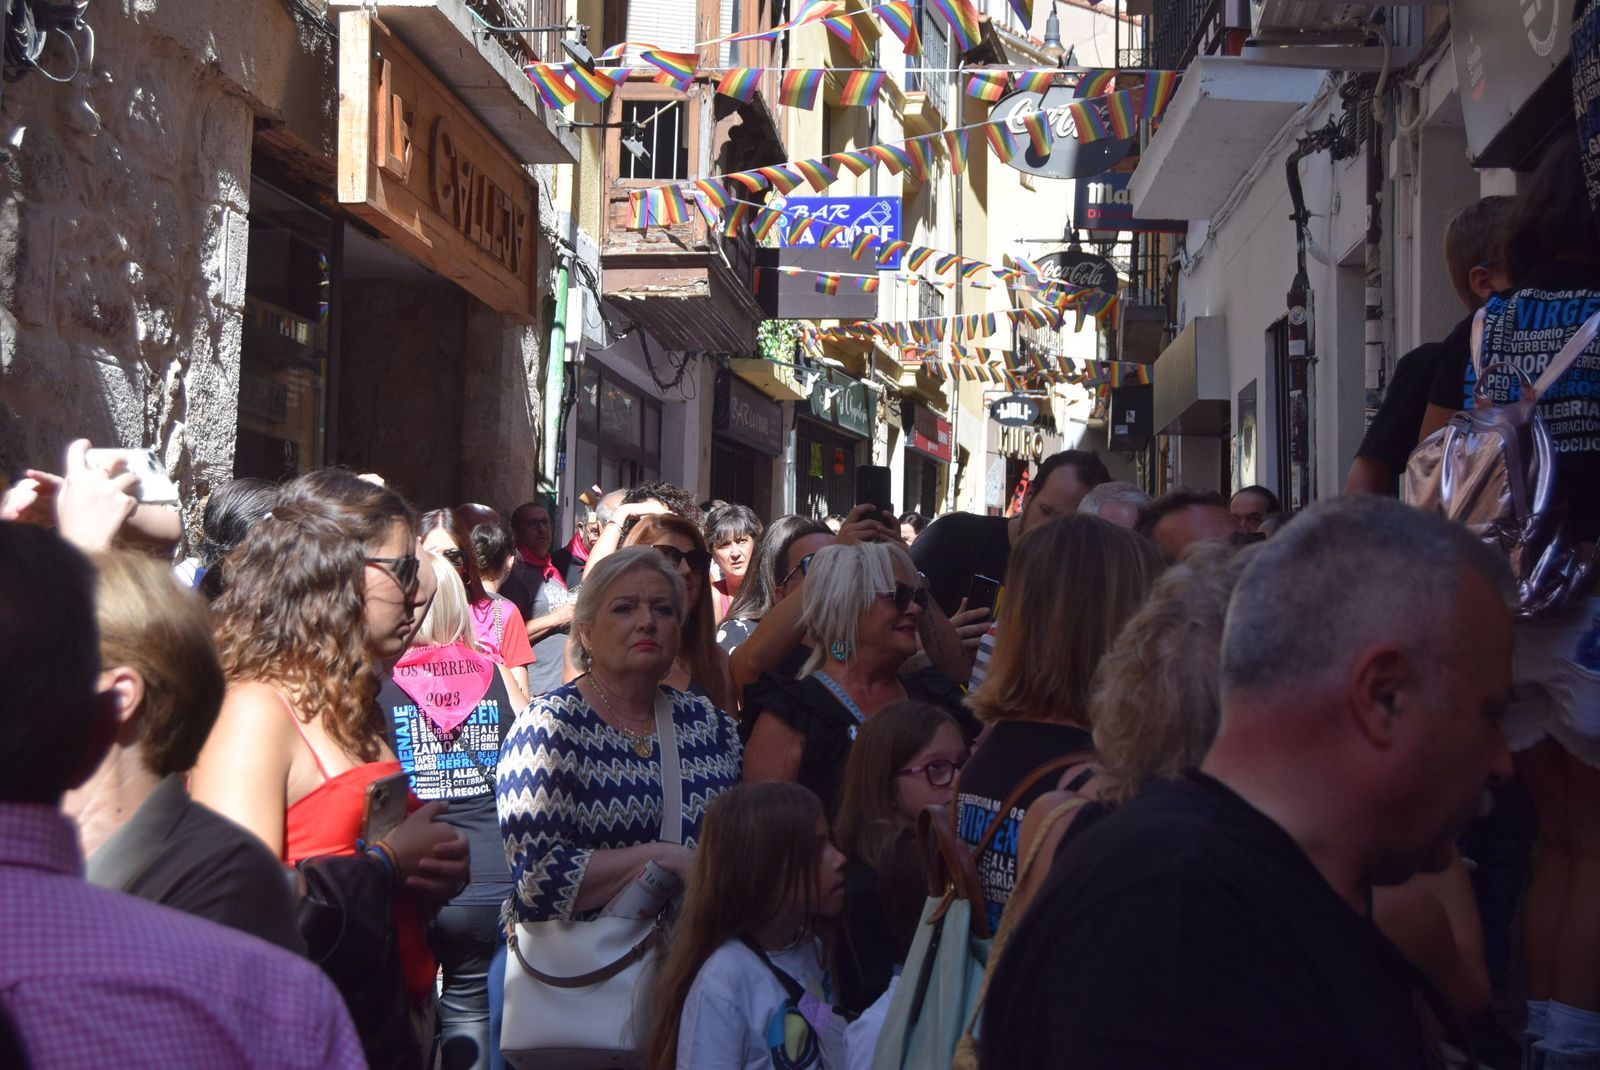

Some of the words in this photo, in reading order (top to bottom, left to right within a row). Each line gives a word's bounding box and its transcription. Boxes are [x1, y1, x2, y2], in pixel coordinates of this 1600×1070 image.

[1087, 181, 1134, 206] Ma
[789, 204, 850, 221] BAR
[1038, 259, 1106, 286] Coca-Cola
[1512, 328, 1564, 342] JOLGORIO
[1511, 341, 1563, 354] VERBENA
[421, 658, 485, 677] HERREROS
[426, 691, 460, 707] 2023
[410, 718, 419, 744] FIESTA
[481, 725, 499, 734] ALE
[414, 754, 437, 765] TAPEO
[447, 752, 455, 760] LA
